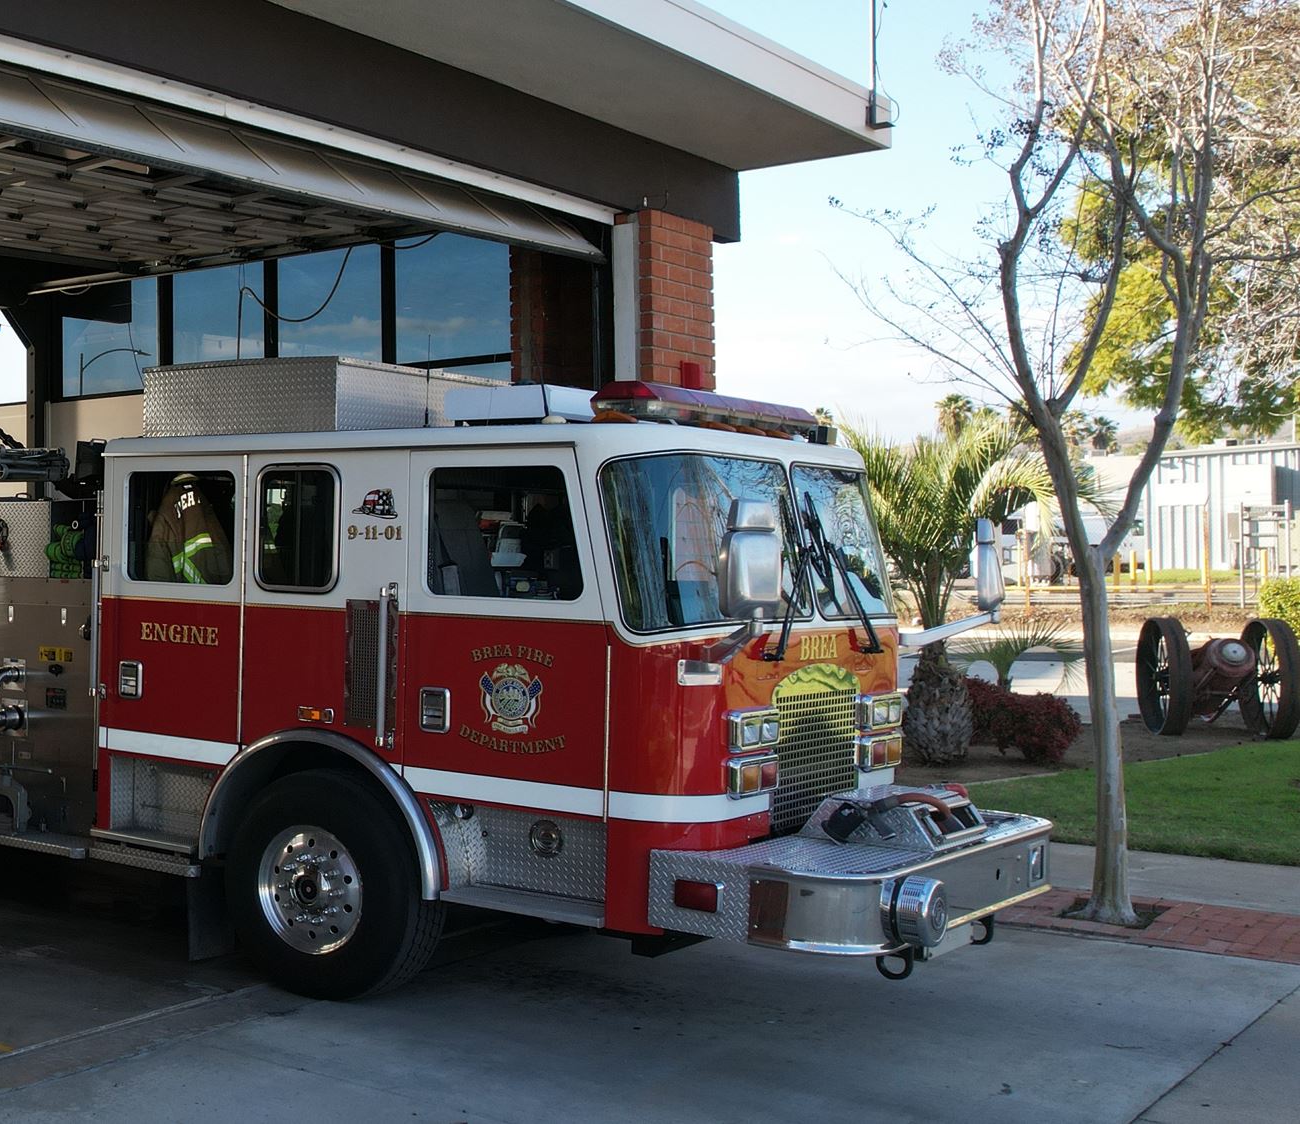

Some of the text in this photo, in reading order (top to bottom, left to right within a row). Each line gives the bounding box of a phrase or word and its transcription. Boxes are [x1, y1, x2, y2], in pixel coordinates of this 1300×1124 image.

[347, 524, 402, 541] 9-11-01
[140, 621, 219, 646] ENGINE
[471, 644, 555, 668] BREA FIRE
[800, 633, 838, 661] BREA
[459, 723, 566, 754] DEPARTMENT
